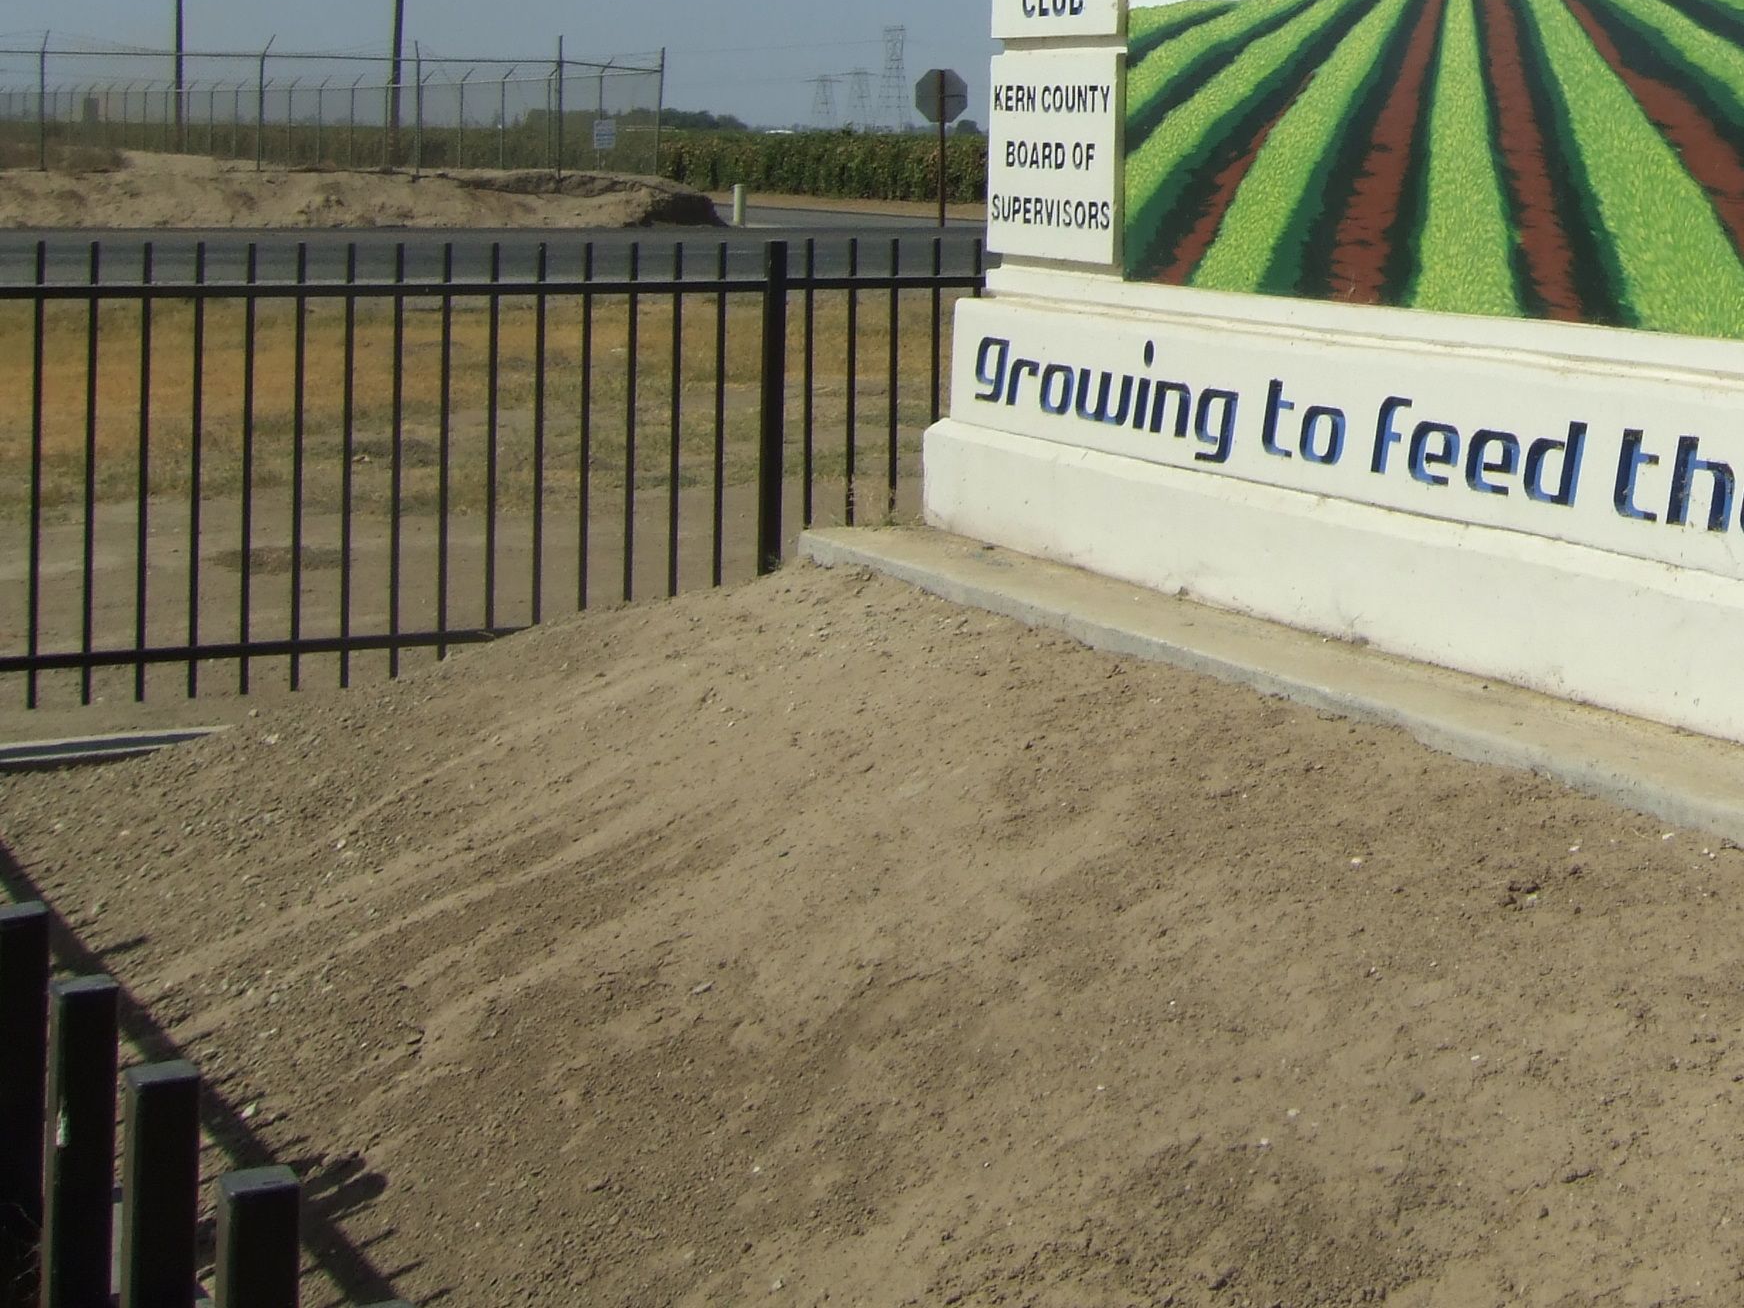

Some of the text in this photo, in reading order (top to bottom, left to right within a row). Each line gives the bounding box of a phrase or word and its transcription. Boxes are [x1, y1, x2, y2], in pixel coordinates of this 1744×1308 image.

[993, 85, 1111, 114] KERN COUNTY
[1005, 140, 1096, 171] BOARD OF
[991, 193, 1111, 231] SUPERVISORS
[974, 336, 1238, 464] growing
[1261, 378, 1346, 466] to
[1369, 395, 1590, 508] feed
